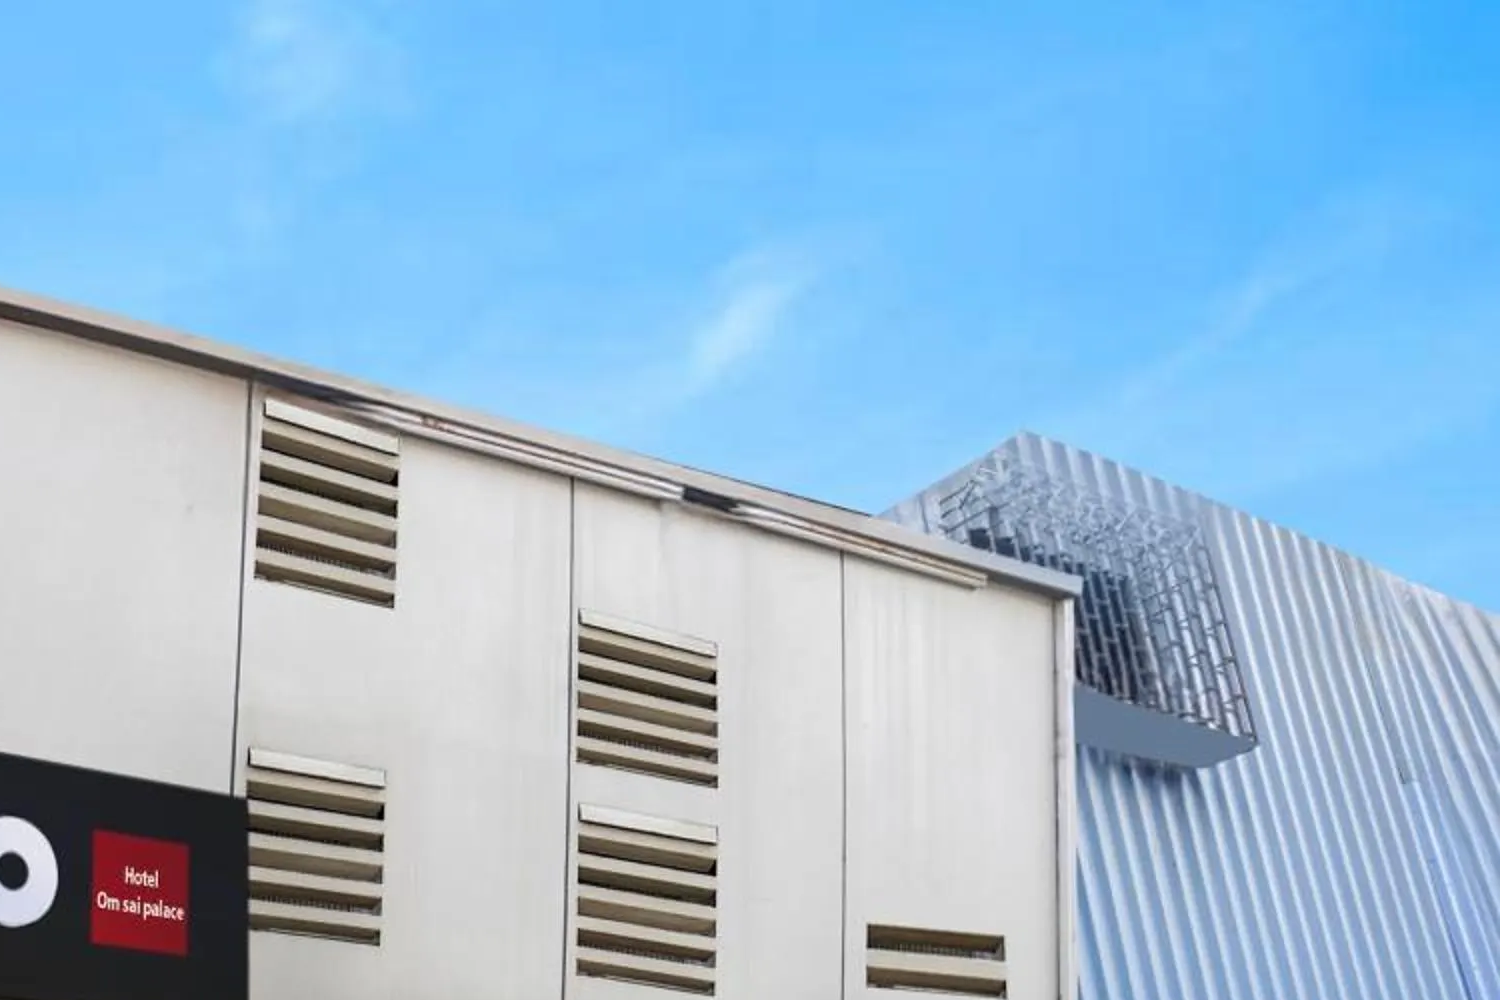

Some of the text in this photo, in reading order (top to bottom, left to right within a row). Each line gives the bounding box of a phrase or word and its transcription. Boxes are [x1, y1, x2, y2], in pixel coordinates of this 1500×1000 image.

[124, 865, 159, 888] Hotel
[97, 891, 185, 921] Om sai palace
